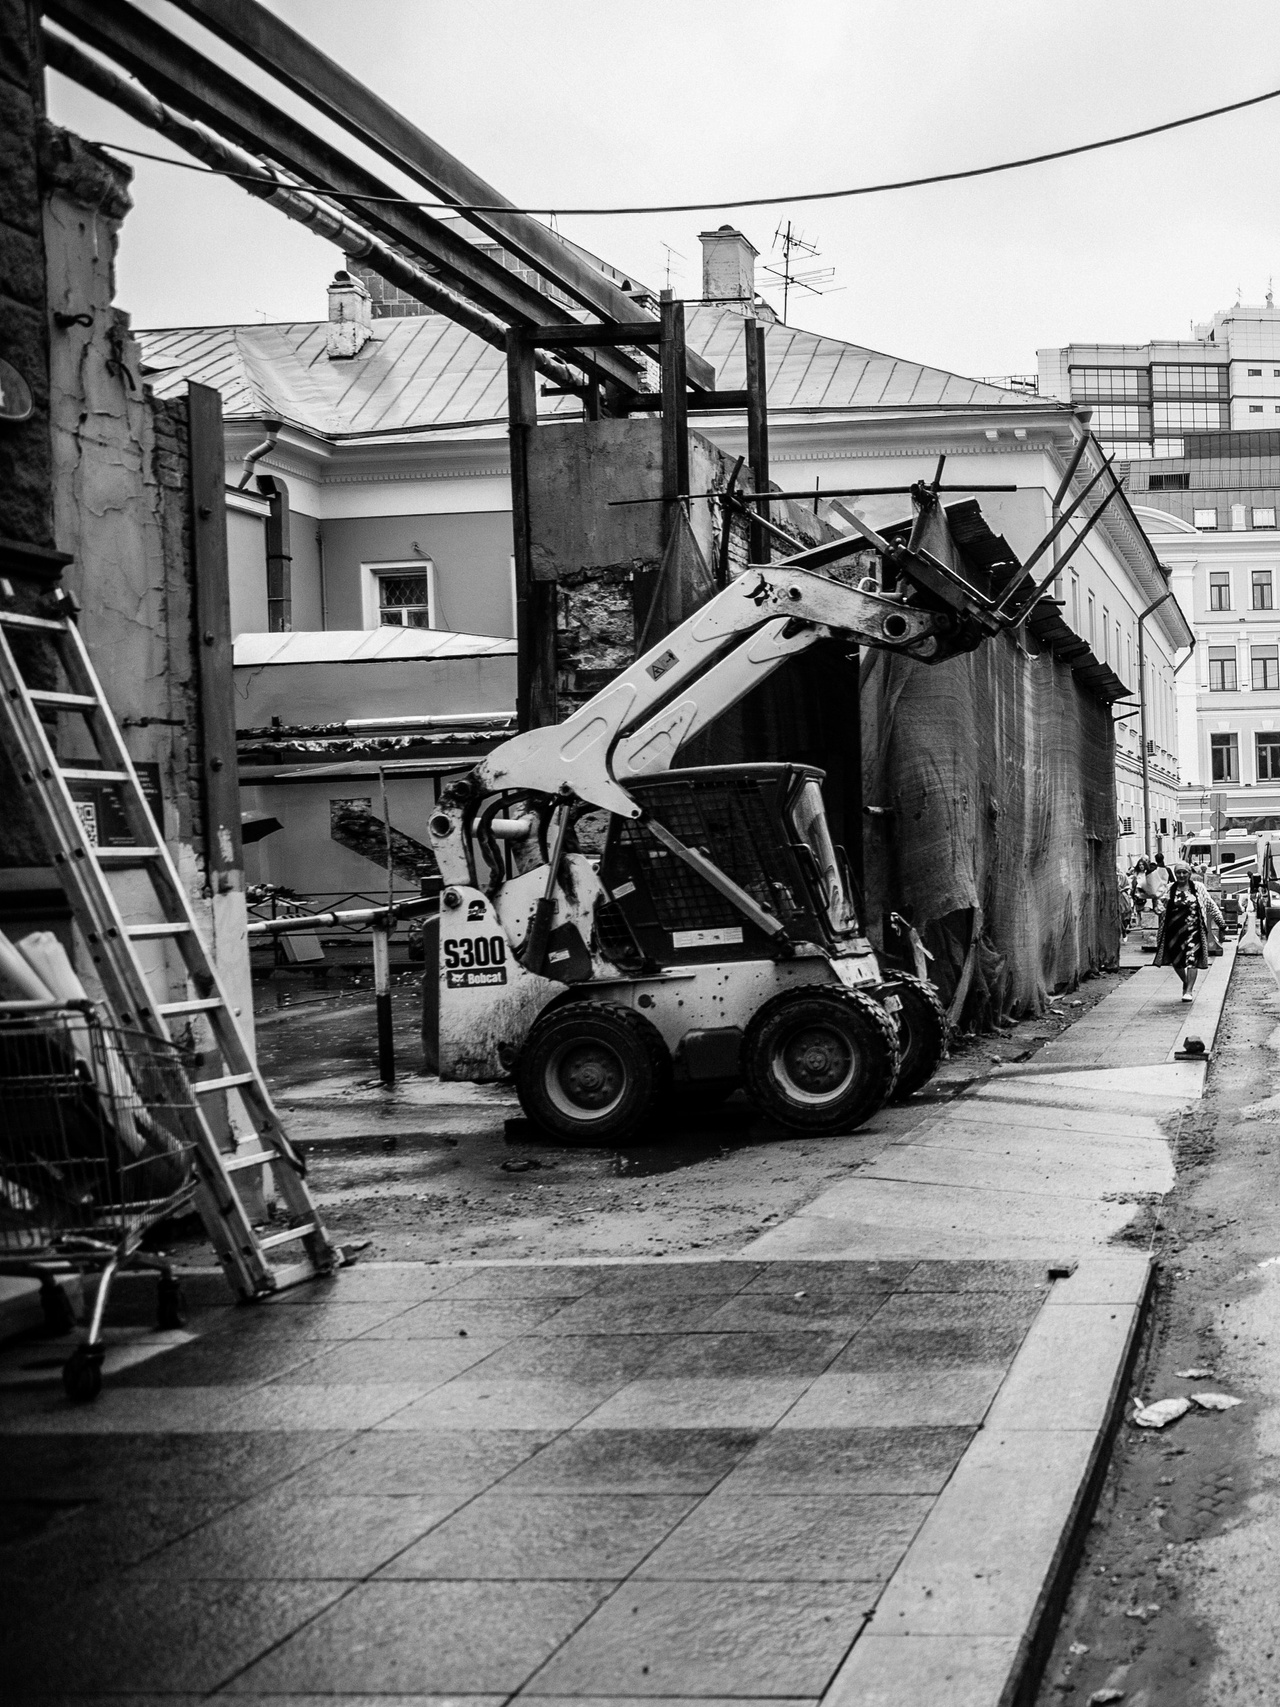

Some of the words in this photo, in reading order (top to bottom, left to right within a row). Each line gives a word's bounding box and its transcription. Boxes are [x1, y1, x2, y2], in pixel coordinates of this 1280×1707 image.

[467, 900, 485, 921] 2
[444, 936, 506, 968] S300
[467, 972, 502, 984] Bobcat
